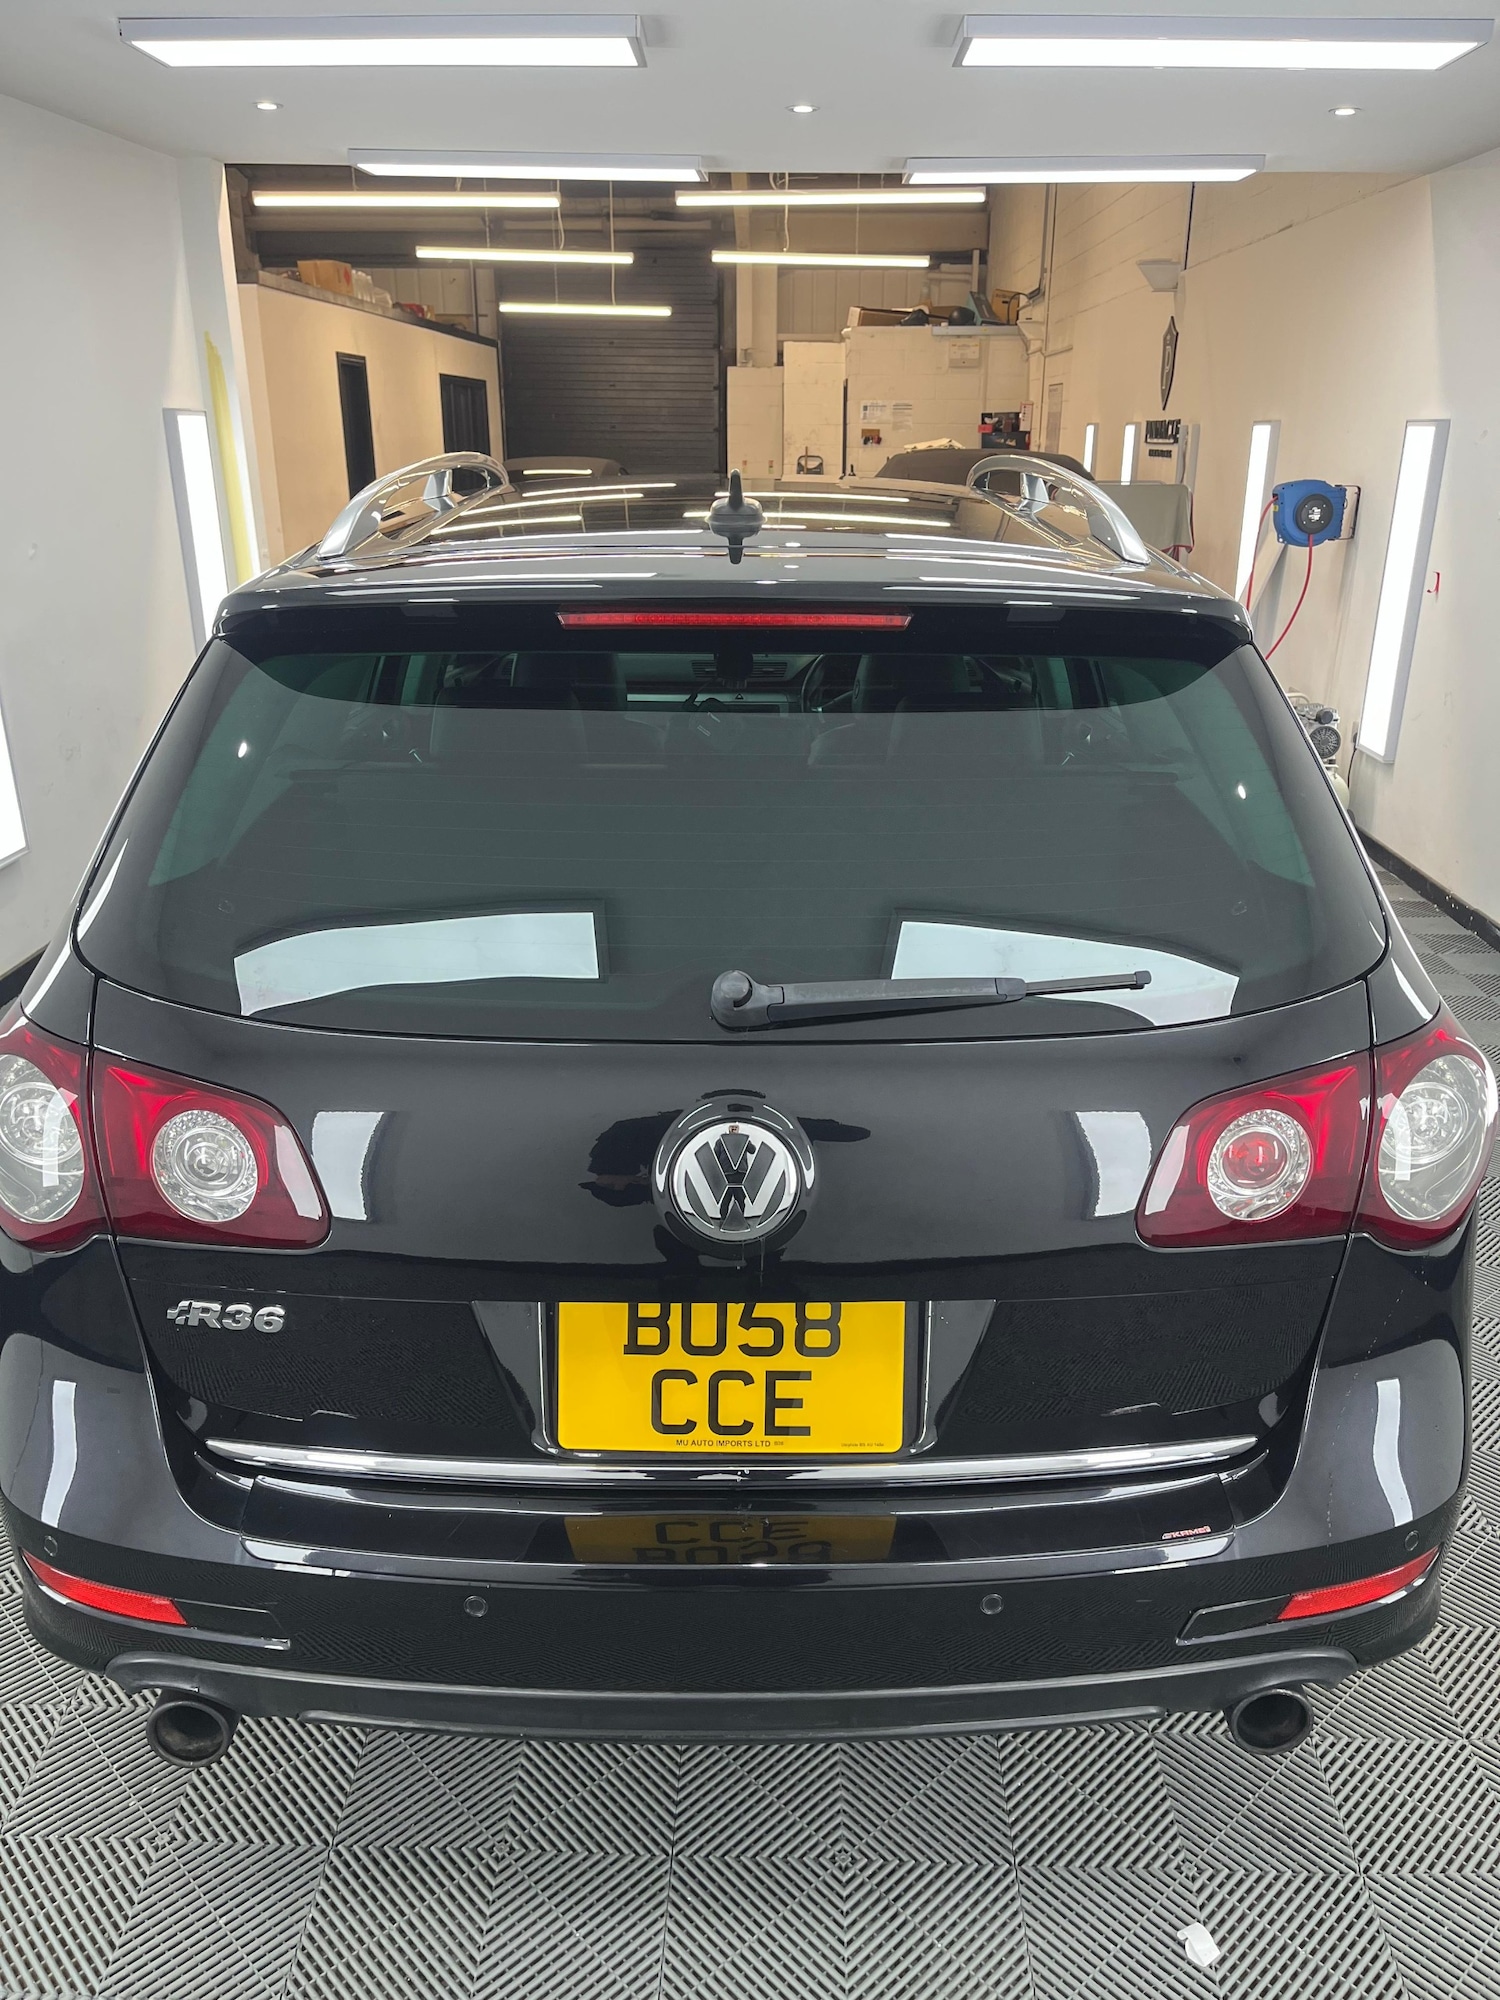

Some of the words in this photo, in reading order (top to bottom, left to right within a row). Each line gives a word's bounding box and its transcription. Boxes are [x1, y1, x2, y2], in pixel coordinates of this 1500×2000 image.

[187, 1300, 286, 1334] R36
[651, 1369, 812, 1437] CCE
[691, 1439, 714, 1447] AUTO
